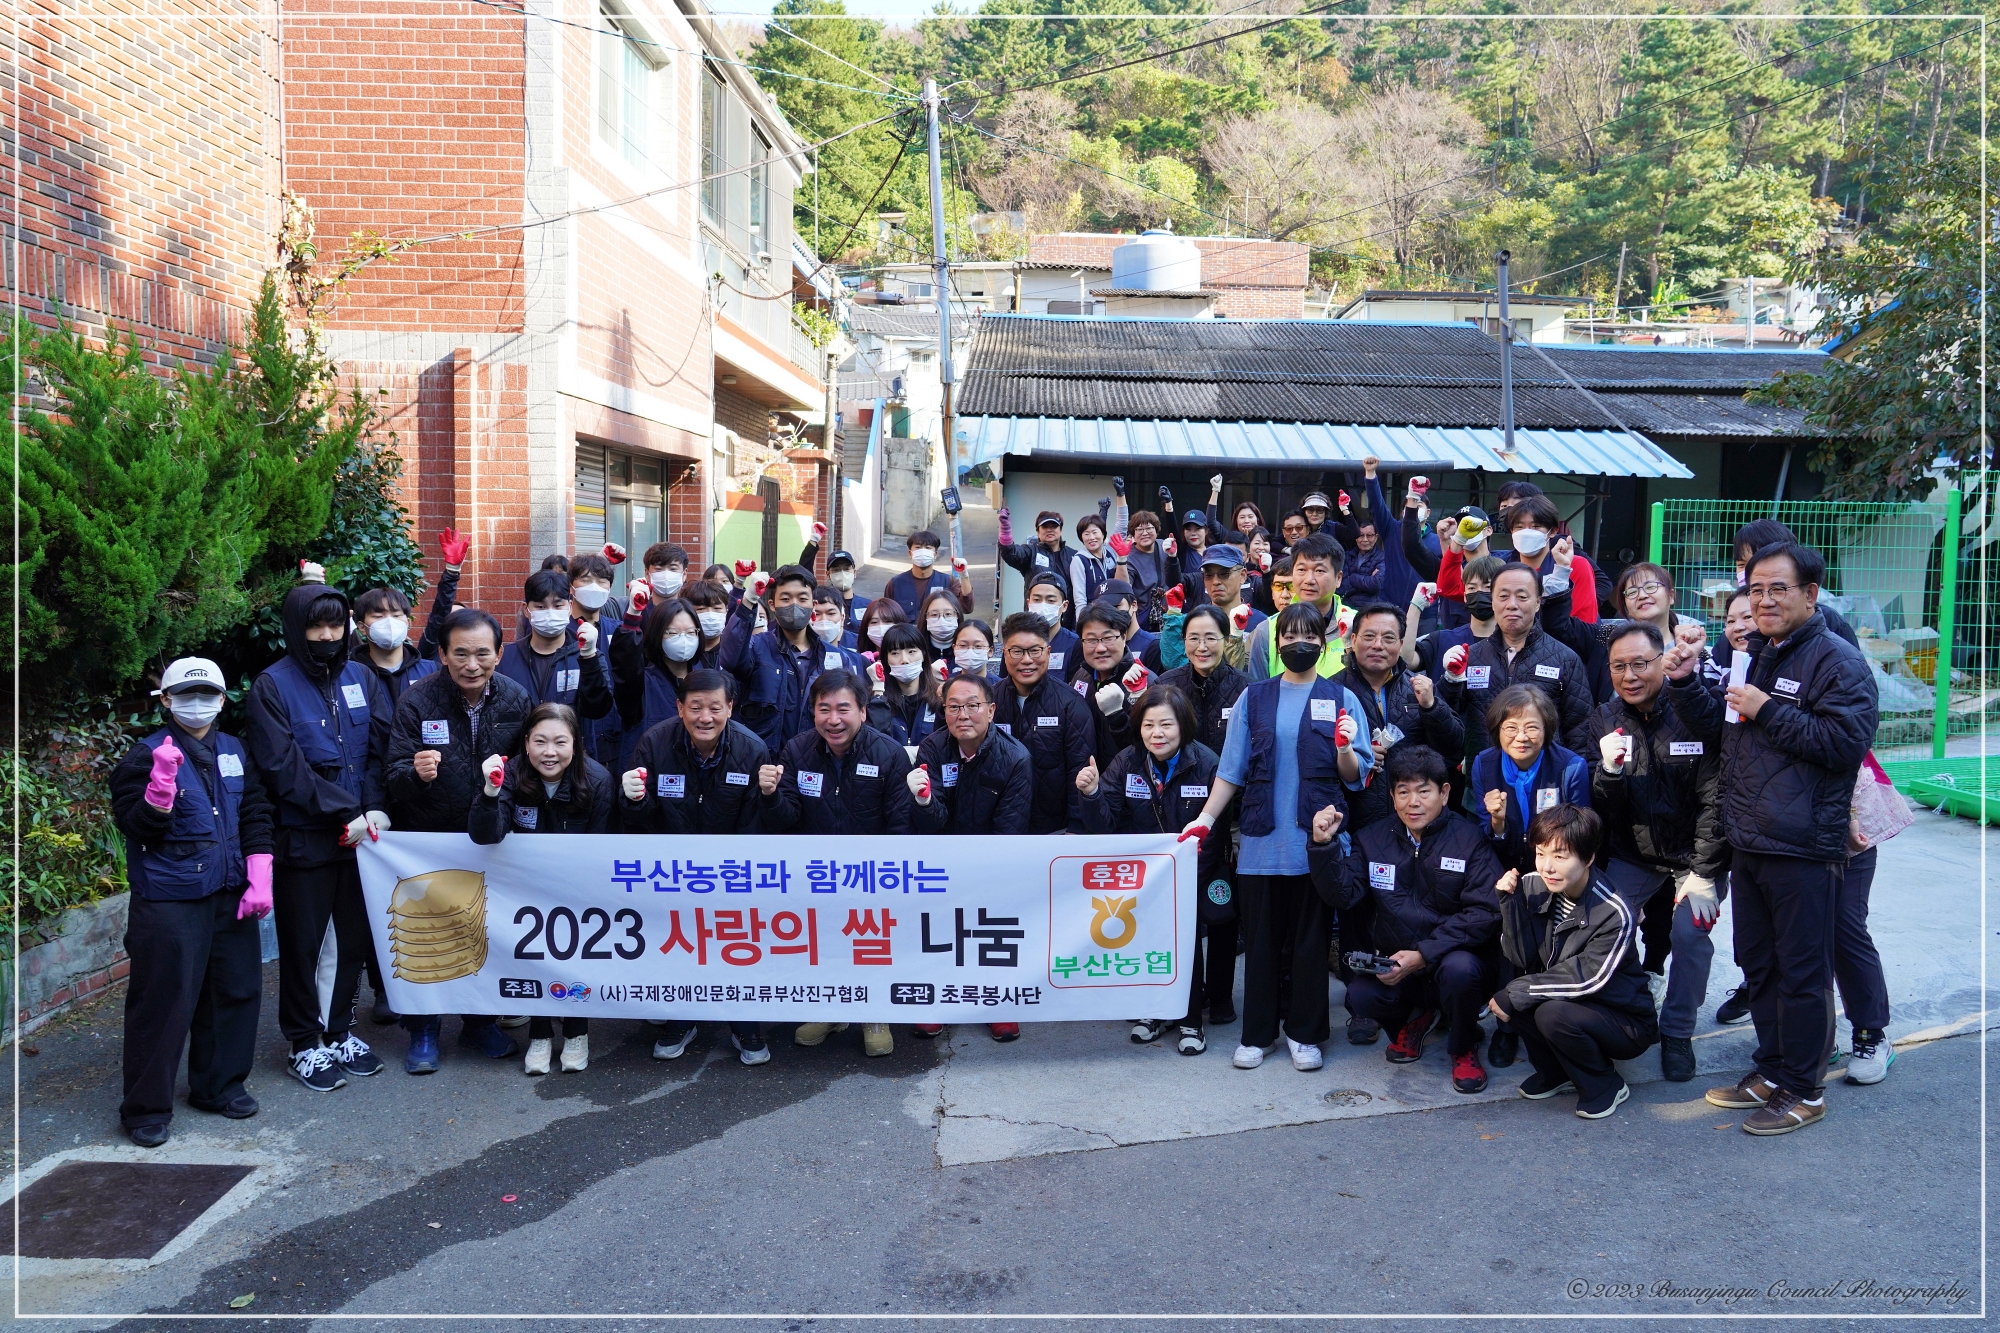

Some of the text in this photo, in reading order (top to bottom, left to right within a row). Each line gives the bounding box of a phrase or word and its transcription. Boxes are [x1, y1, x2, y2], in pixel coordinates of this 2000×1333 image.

[611, 859, 949, 894] 부산농협과 함께하는
[1089, 862, 1139, 888] 후원
[513, 905, 1025, 968] 2023 사랑의 쌀 나눔
[1051, 950, 1173, 979] 부산농협
[504, 980, 538, 998] 주최
[896, 985, 930, 1003] 주관
[940, 984, 1042, 1007] 초록봉사단
